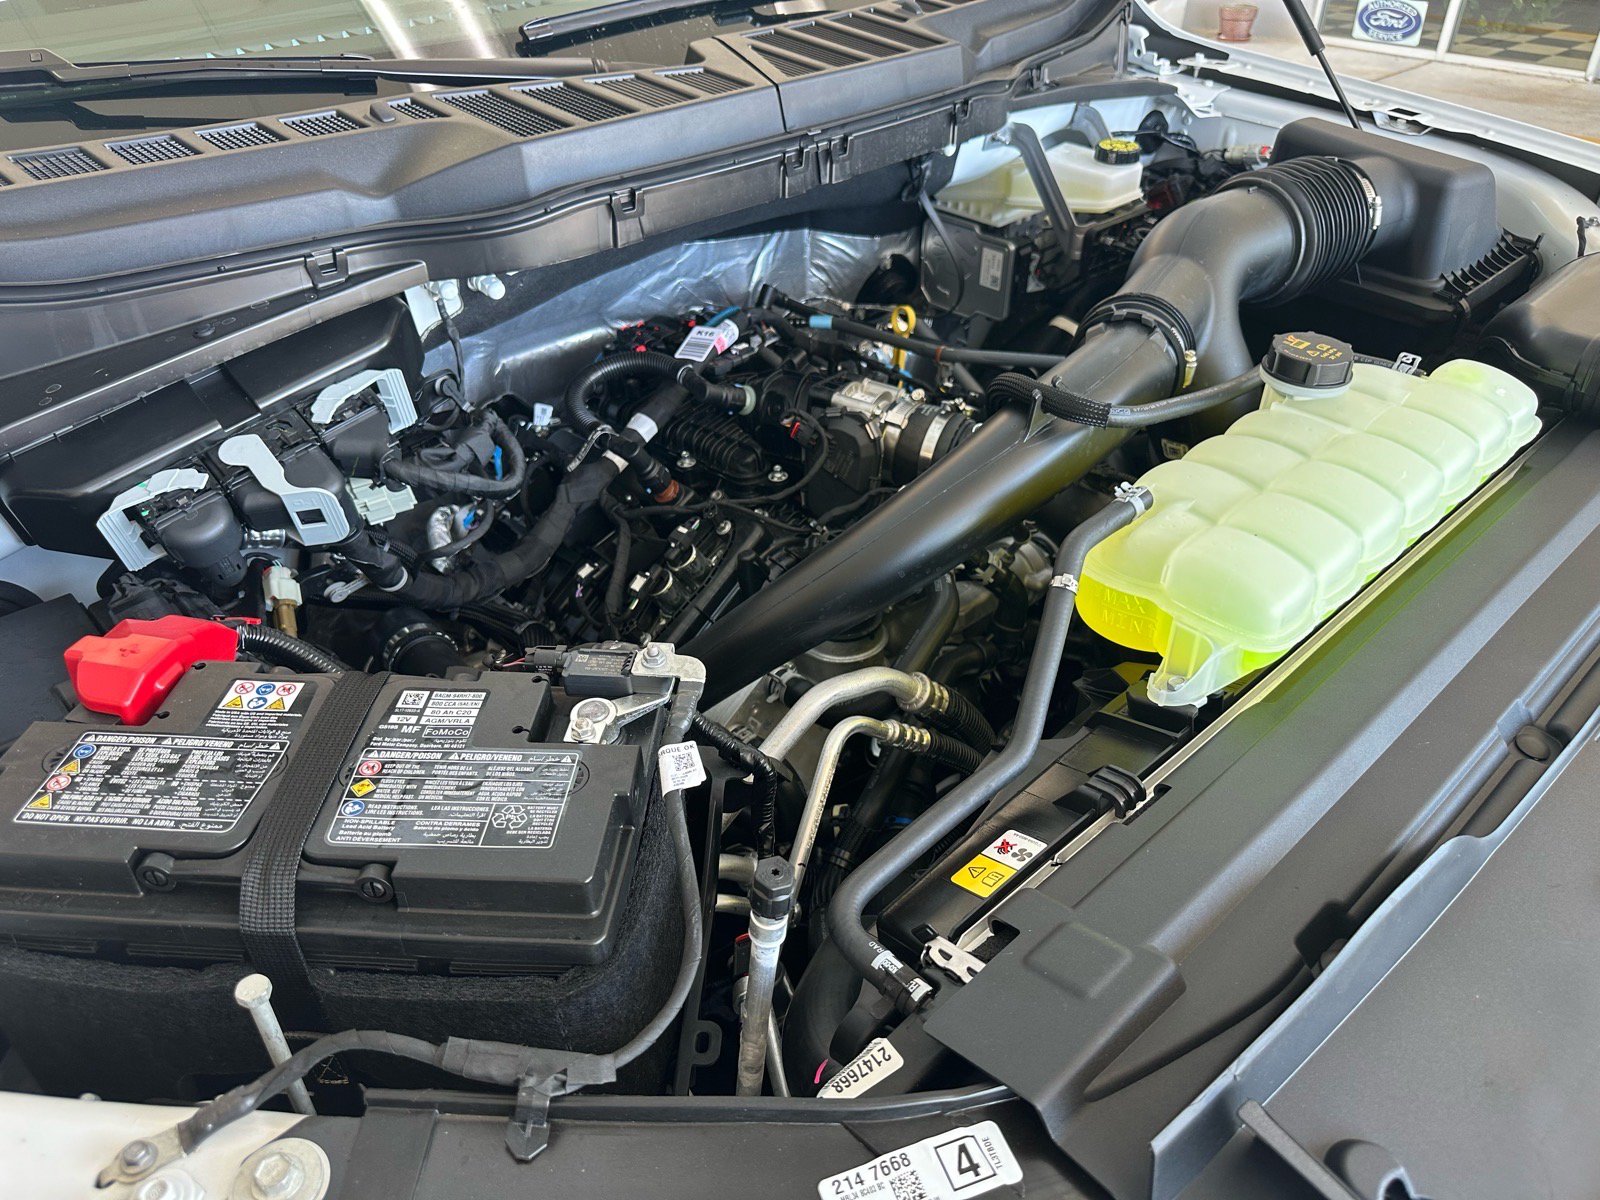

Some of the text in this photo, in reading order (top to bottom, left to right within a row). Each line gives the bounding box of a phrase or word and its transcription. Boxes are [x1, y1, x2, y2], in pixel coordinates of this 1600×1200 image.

[1370, 10, 1409, 29] Ford
[1368, 28, 1403, 41] SERVICE
[1103, 588, 1146, 614] MAX
[1102, 609, 1143, 634] MIN
[95, 735, 156, 743] DANGER/POISON
[172, 738, 234, 747] PELIGRO/VENENO
[684, 743, 695, 751] OK
[378, 751, 442, 759] DANGER/POISON
[459, 753, 522, 761] PELIGRO/VENENO
[868, 941, 885, 954] RAD
[830, 1046, 892, 1093] 2147668
[957, 1143, 981, 1177] 4
[832, 1152, 911, 1195] 214 7668
